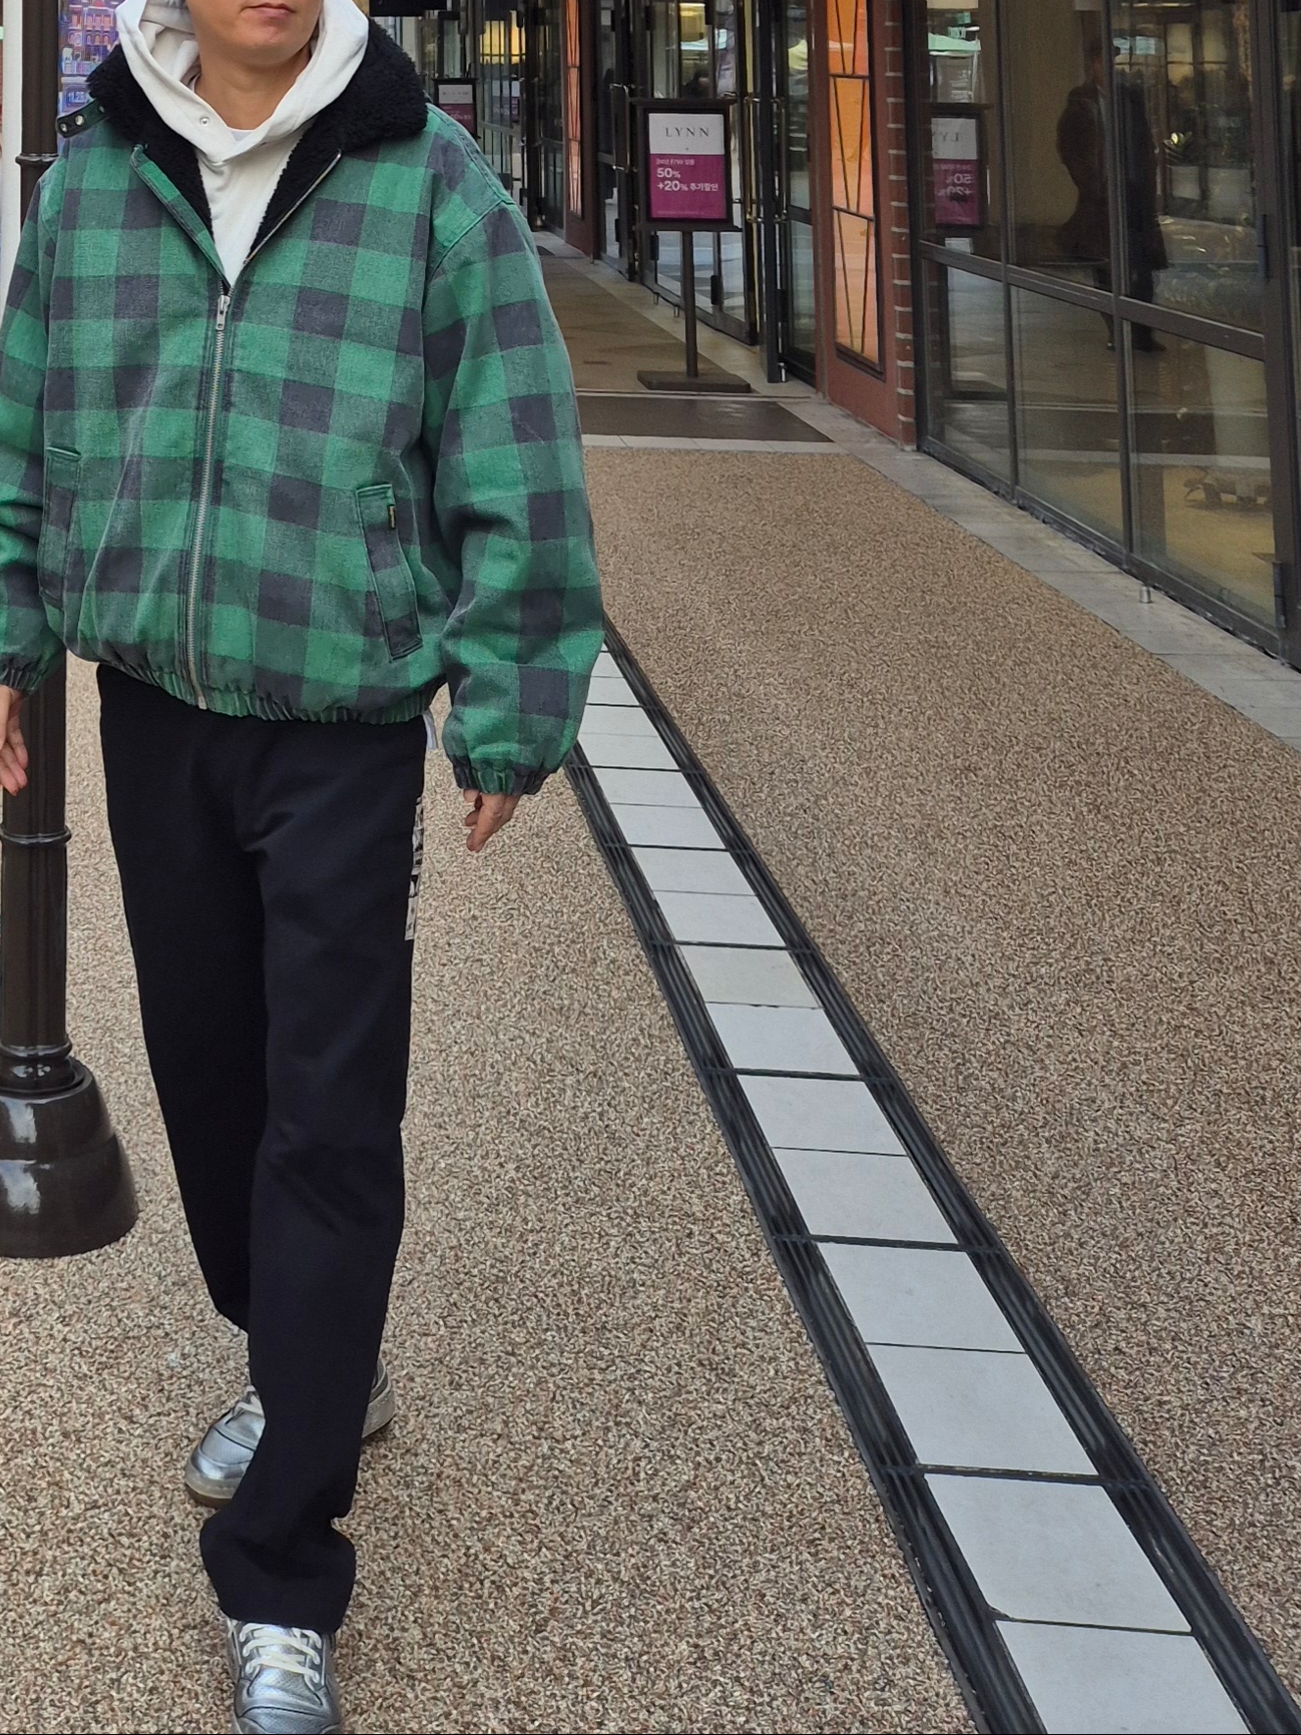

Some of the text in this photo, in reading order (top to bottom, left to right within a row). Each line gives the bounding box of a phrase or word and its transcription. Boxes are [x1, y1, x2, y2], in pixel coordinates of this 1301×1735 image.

[665, 127, 709, 137] LYNN
[656, 167, 681, 178] 50%
[657, 180, 688, 191] +20%
